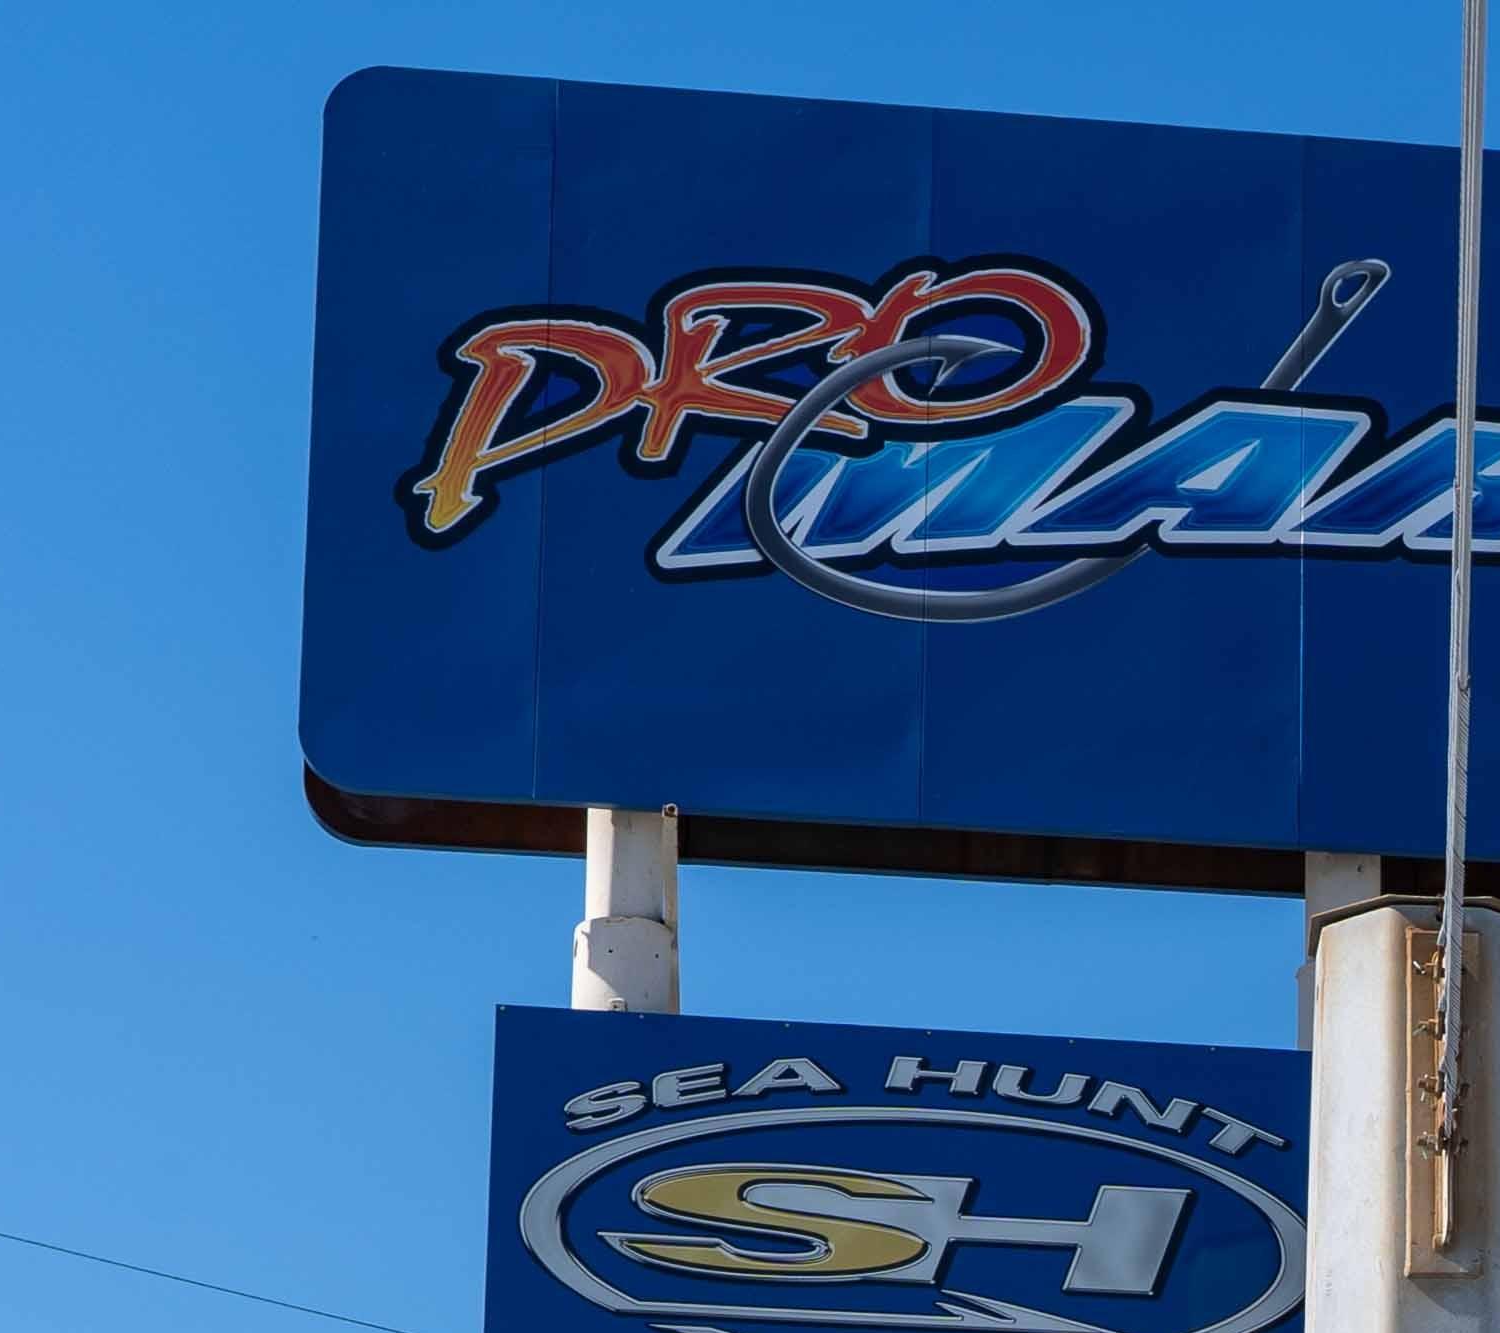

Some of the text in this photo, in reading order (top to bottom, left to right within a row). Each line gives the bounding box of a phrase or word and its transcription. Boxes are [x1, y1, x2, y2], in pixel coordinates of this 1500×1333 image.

[412, 268, 1092, 533] PRO
[563, 1055, 1287, 1156] SEA HUNT
[596, 1162, 1193, 1297] SH
